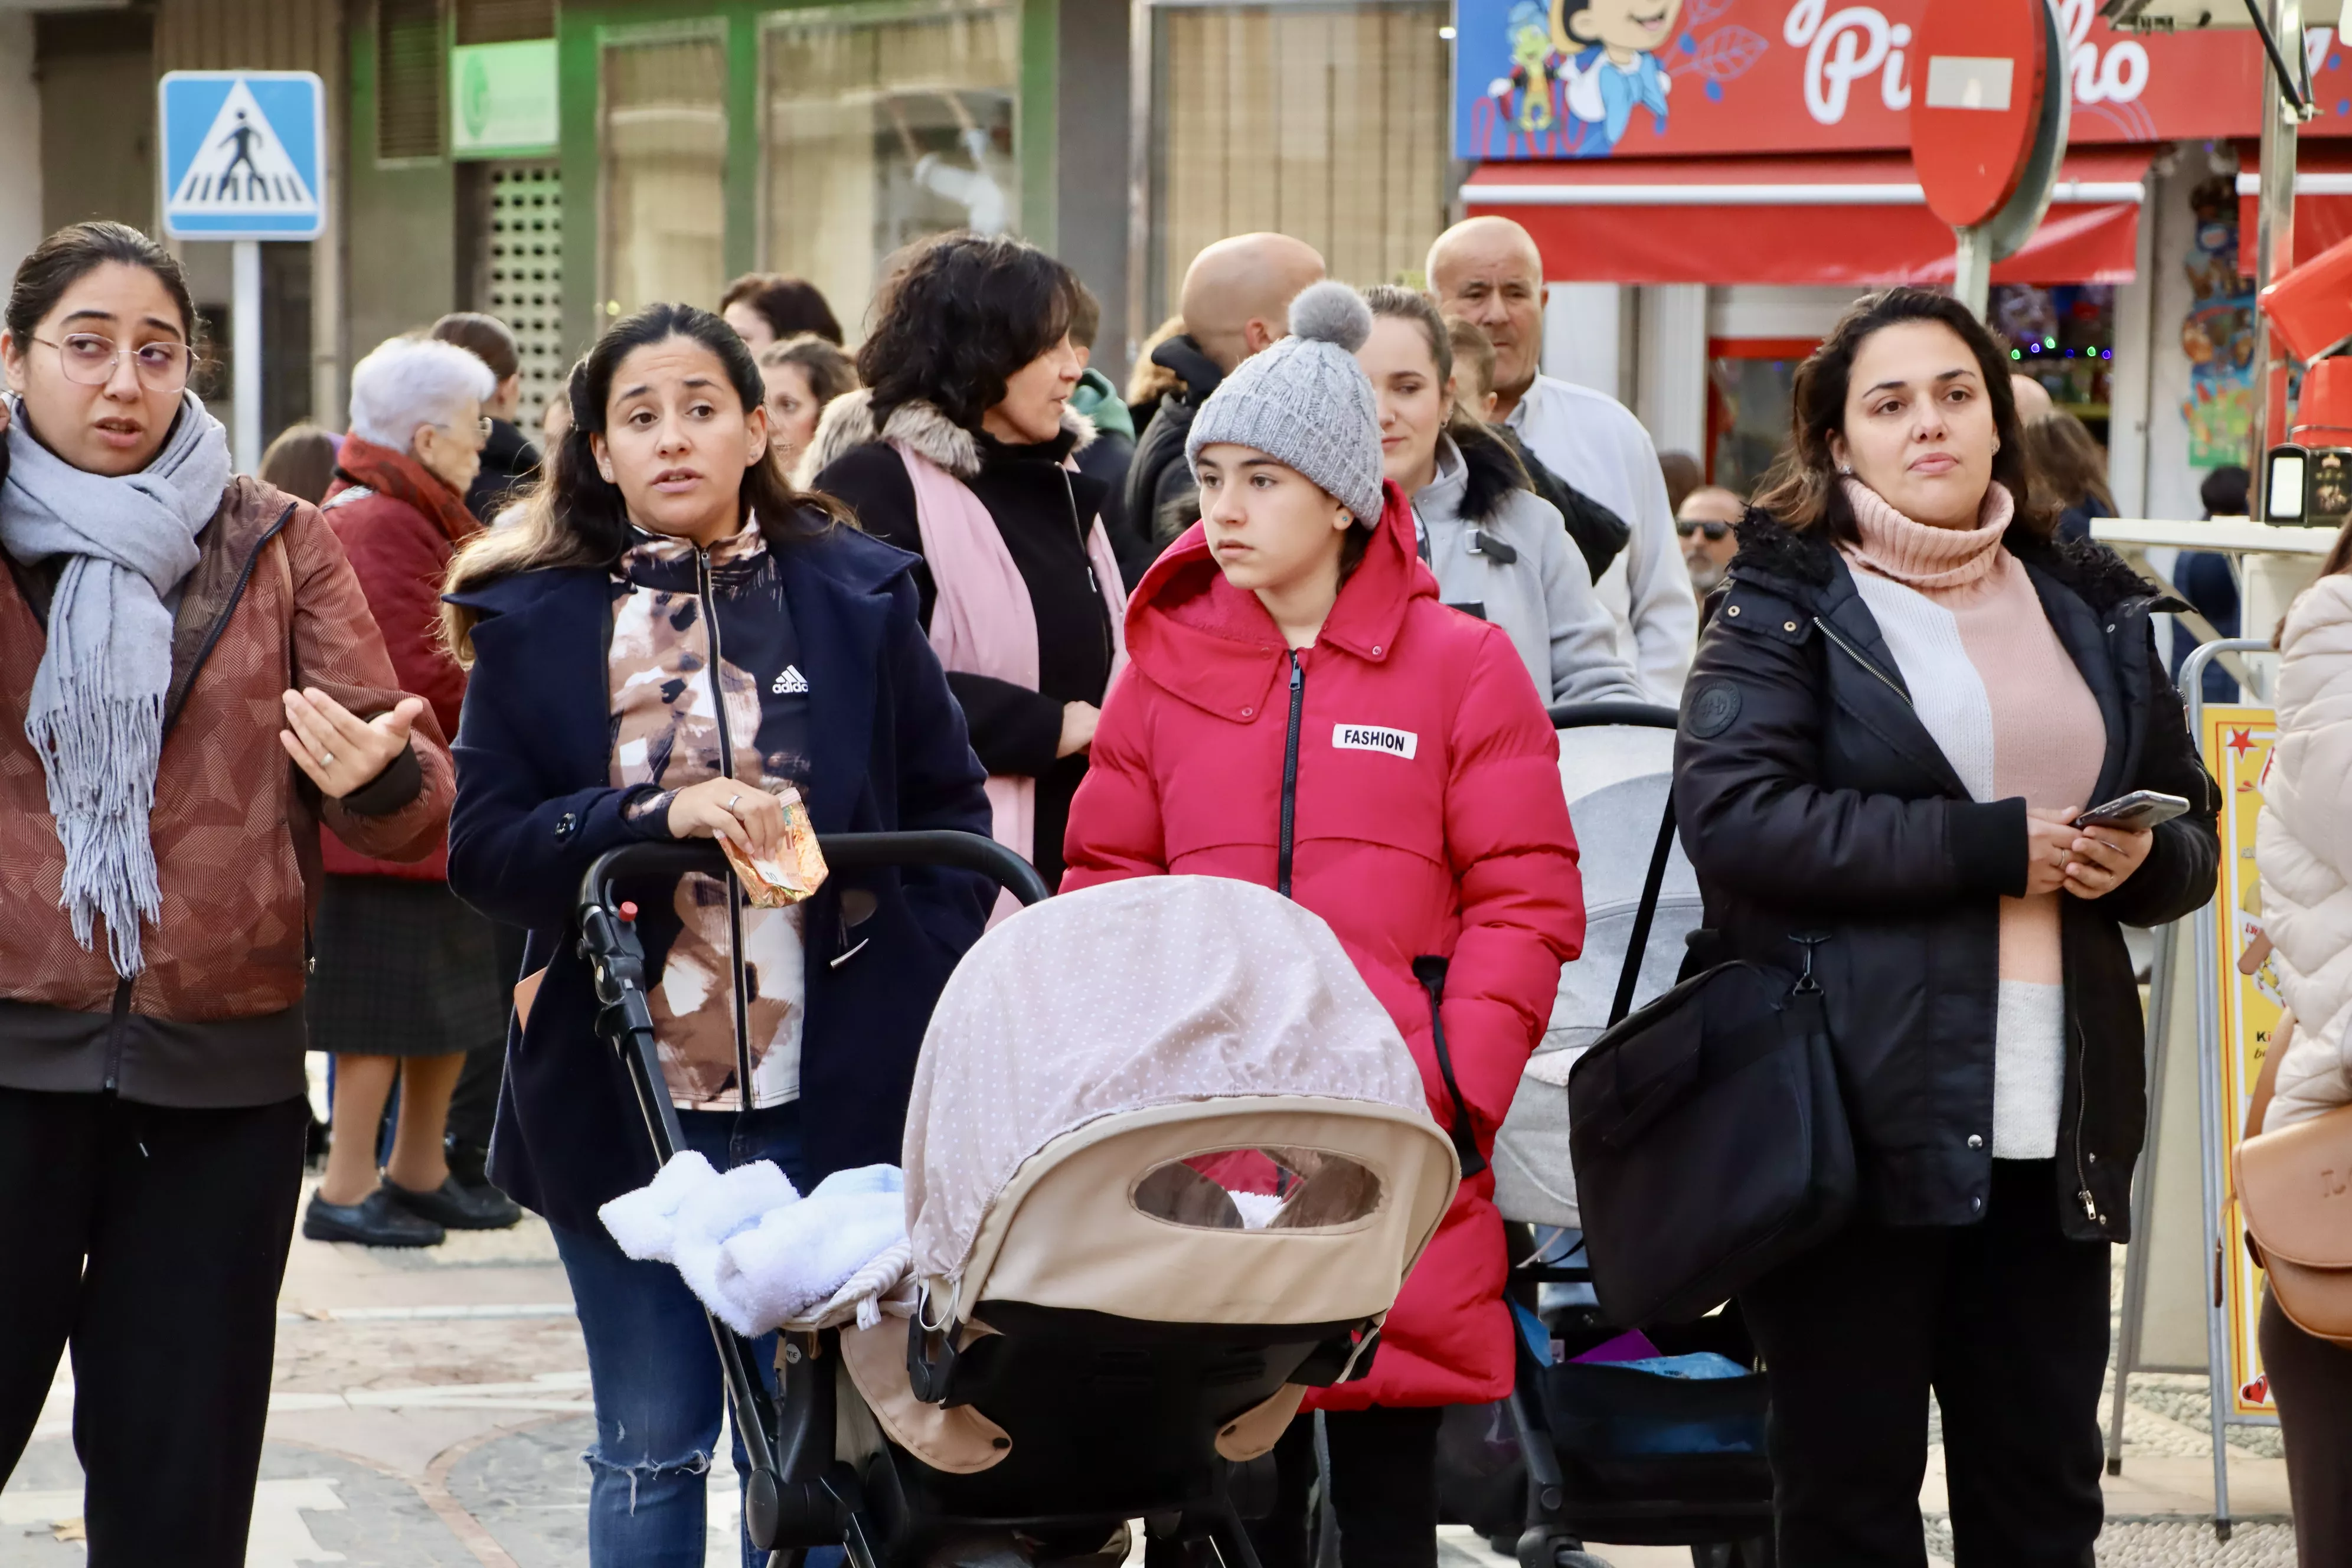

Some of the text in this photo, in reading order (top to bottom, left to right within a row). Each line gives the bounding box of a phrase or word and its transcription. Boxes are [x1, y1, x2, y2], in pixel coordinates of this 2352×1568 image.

[1804, 0, 2150, 125] Piho
[772, 681, 809, 694] adida
[1344, 730, 1405, 752] FASHION
[765, 871, 779, 882] 10
